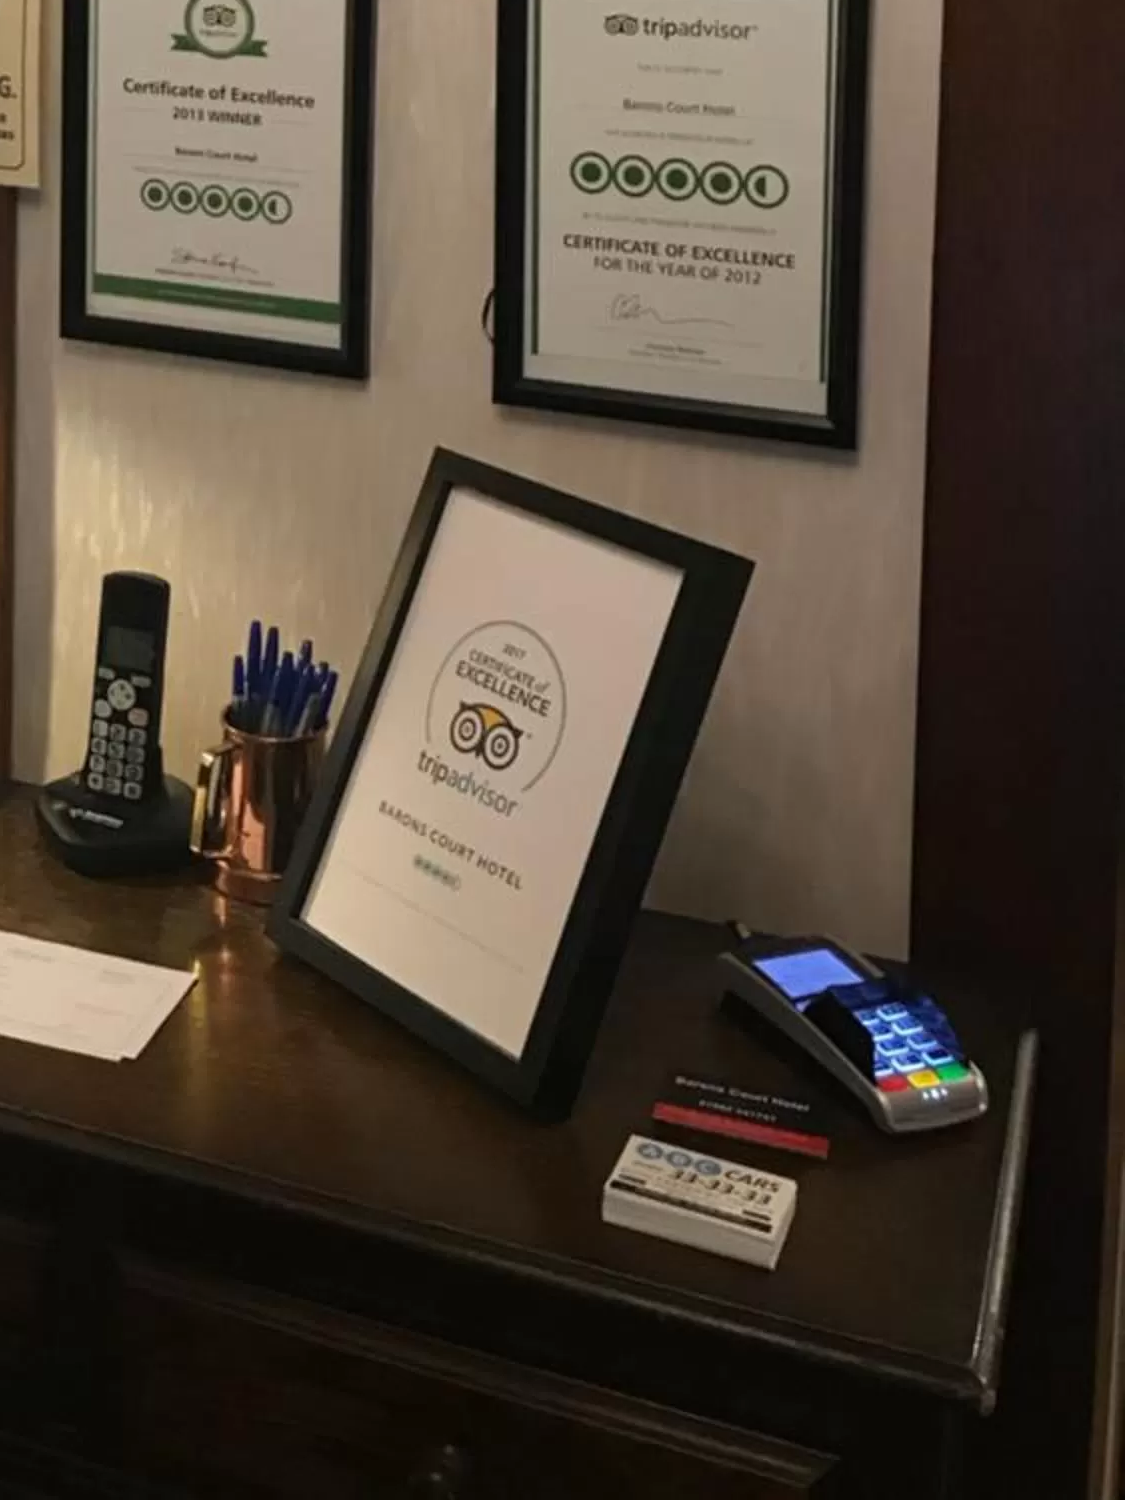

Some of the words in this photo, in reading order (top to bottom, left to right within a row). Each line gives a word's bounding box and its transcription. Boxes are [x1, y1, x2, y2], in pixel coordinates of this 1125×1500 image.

[642, 15, 751, 42] tripadvisor
[122, 77, 205, 100] Certificate
[208, 83, 227, 101] of
[230, 85, 316, 109] Excellence
[667, 101, 700, 115] Court
[172, 104, 205, 122] 2013
[207, 108, 263, 127] WINNER
[562, 233, 660, 257] CERTIFICATE
[664, 242, 687, 261] OF
[692, 244, 796, 270] EXCELLENCE
[593, 255, 623, 272] FOR
[627, 258, 653, 275] THE
[658, 262, 696, 280] YEAR
[699, 265, 720, 281] OF
[724, 268, 763, 286] 2012
[468, 647, 536, 690] CERTIFICATE
[534, 680, 552, 694] of
[455, 658, 552, 718] EXCELLENCE
[416, 748, 520, 817] tripadvisor
[378, 799, 428, 838] BARONS
[429, 828, 476, 864] COURT
[476, 853, 523, 891] HOTEL
[724, 1169, 783, 1194] CARS
